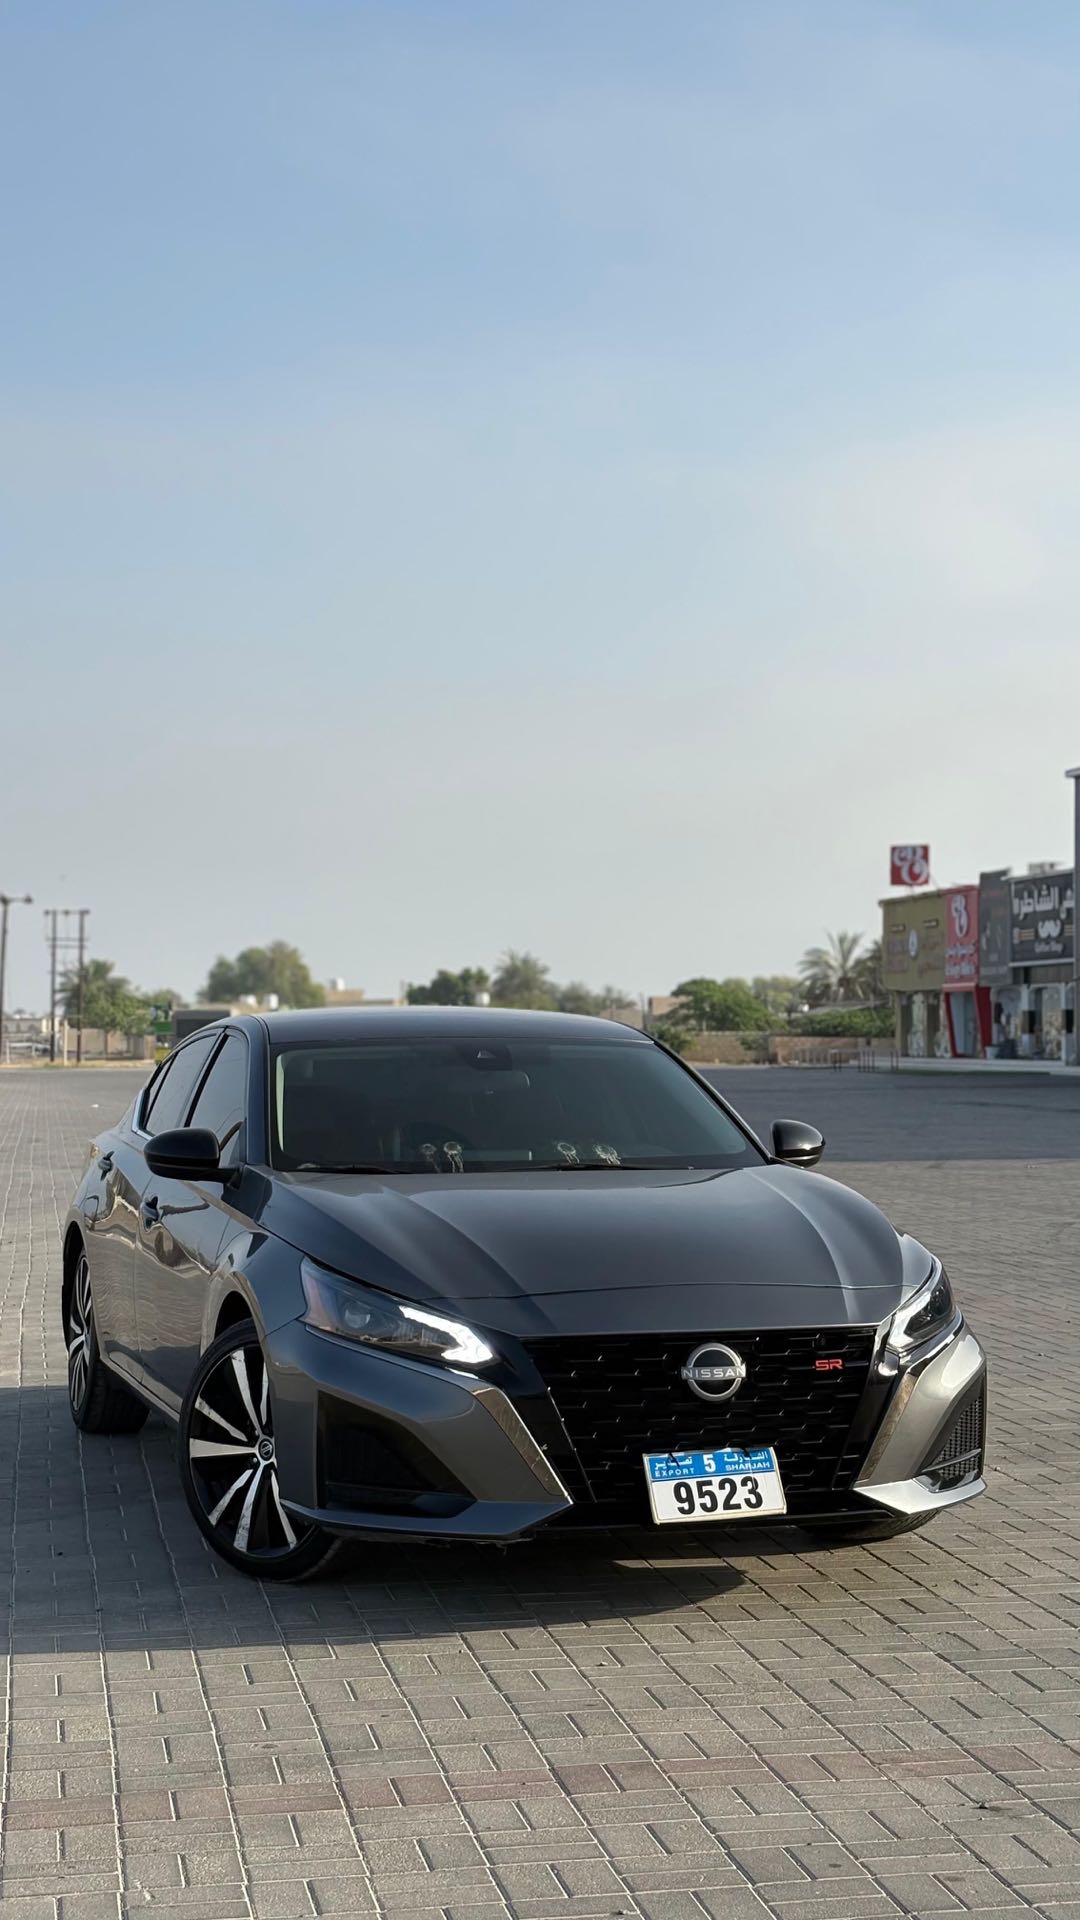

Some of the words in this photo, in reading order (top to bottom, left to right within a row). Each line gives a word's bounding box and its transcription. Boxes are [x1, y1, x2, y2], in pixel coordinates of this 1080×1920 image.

[815, 1359, 843, 1371] SR
[682, 1367, 745, 1379] NISSAN
[703, 1454, 716, 1473] 5
[725, 1461, 770, 1471] SHARJAH
[655, 1467, 695, 1478] EXPORT
[673, 1476, 763, 1515] 9523
